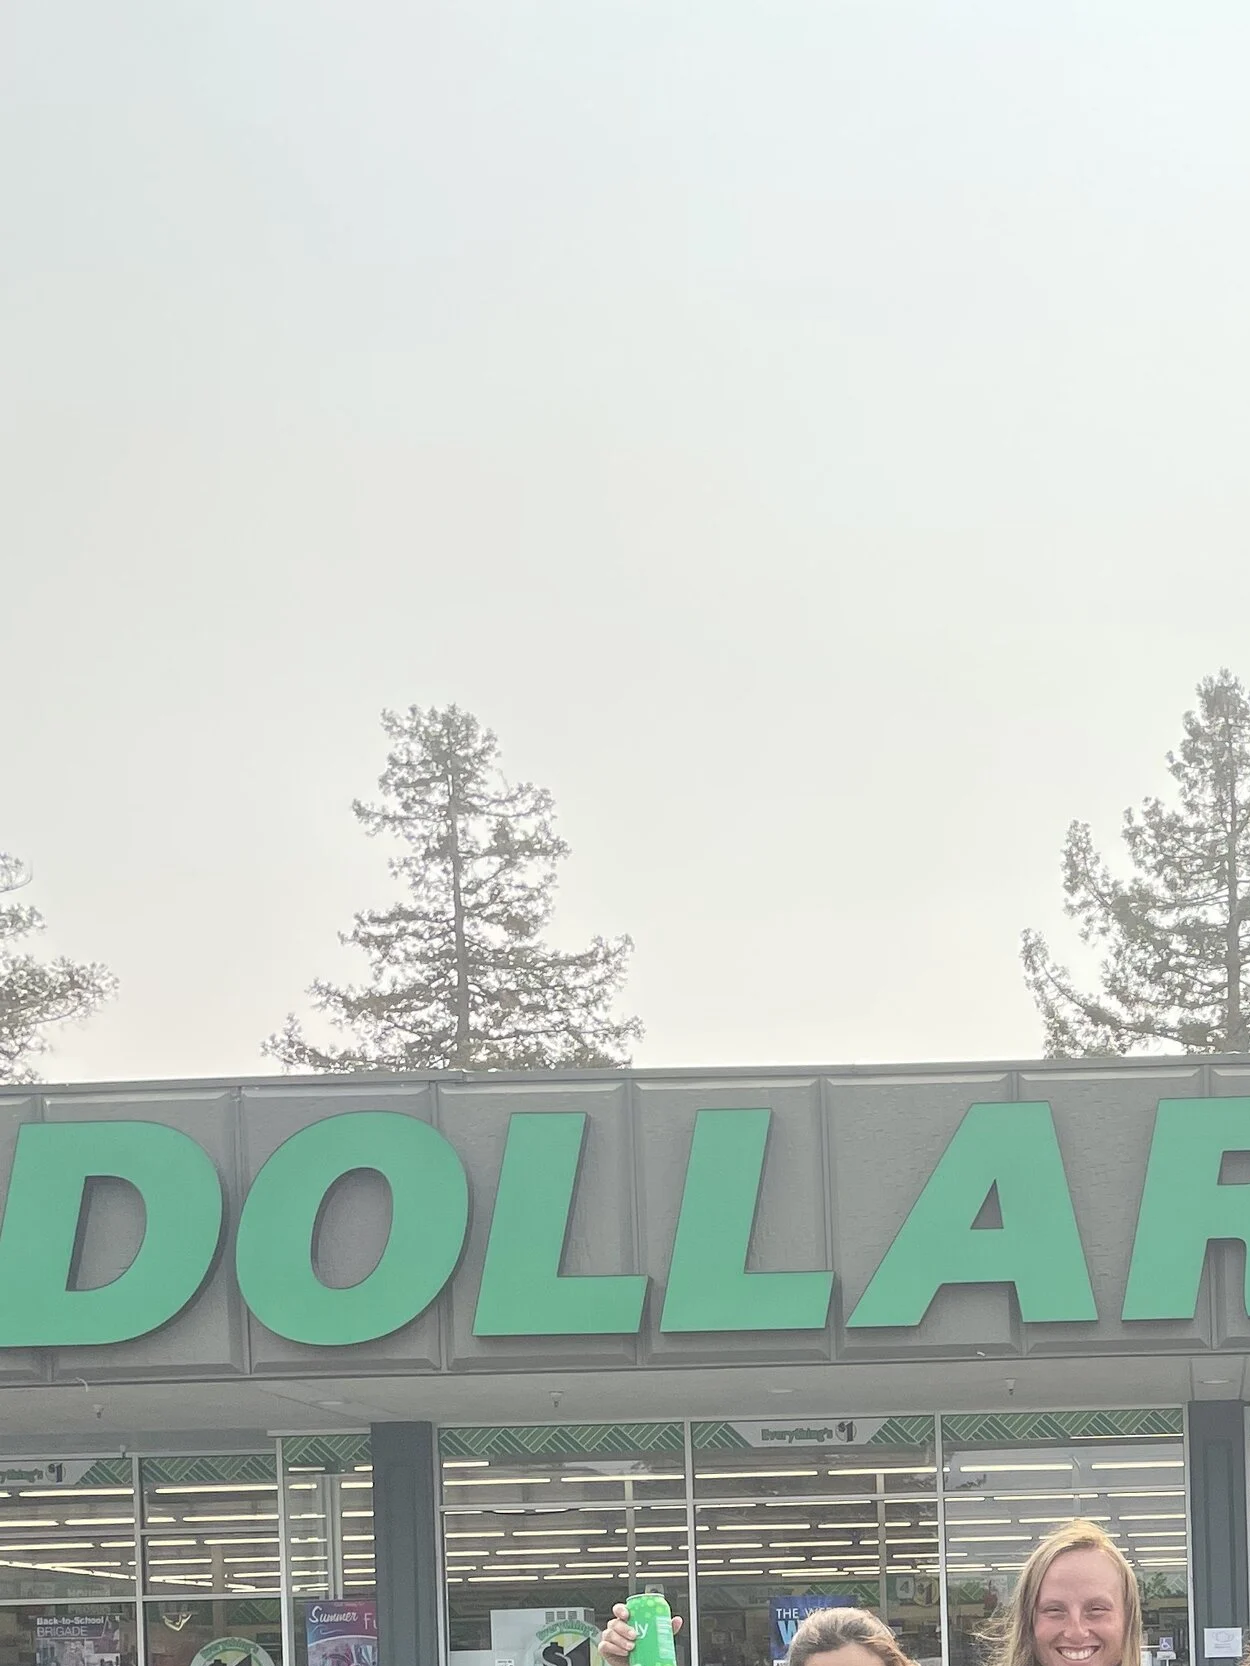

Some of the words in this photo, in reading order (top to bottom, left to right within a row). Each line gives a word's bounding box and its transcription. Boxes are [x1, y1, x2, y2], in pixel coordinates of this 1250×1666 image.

[761, 1427, 834, 1444] Everything's
[308, 1605, 358, 1624] Summer
[776, 1608, 799, 1619] THE
[36, 1616, 104, 1626] Back-to-School
[37, 1626, 88, 1637] BRIGADE
